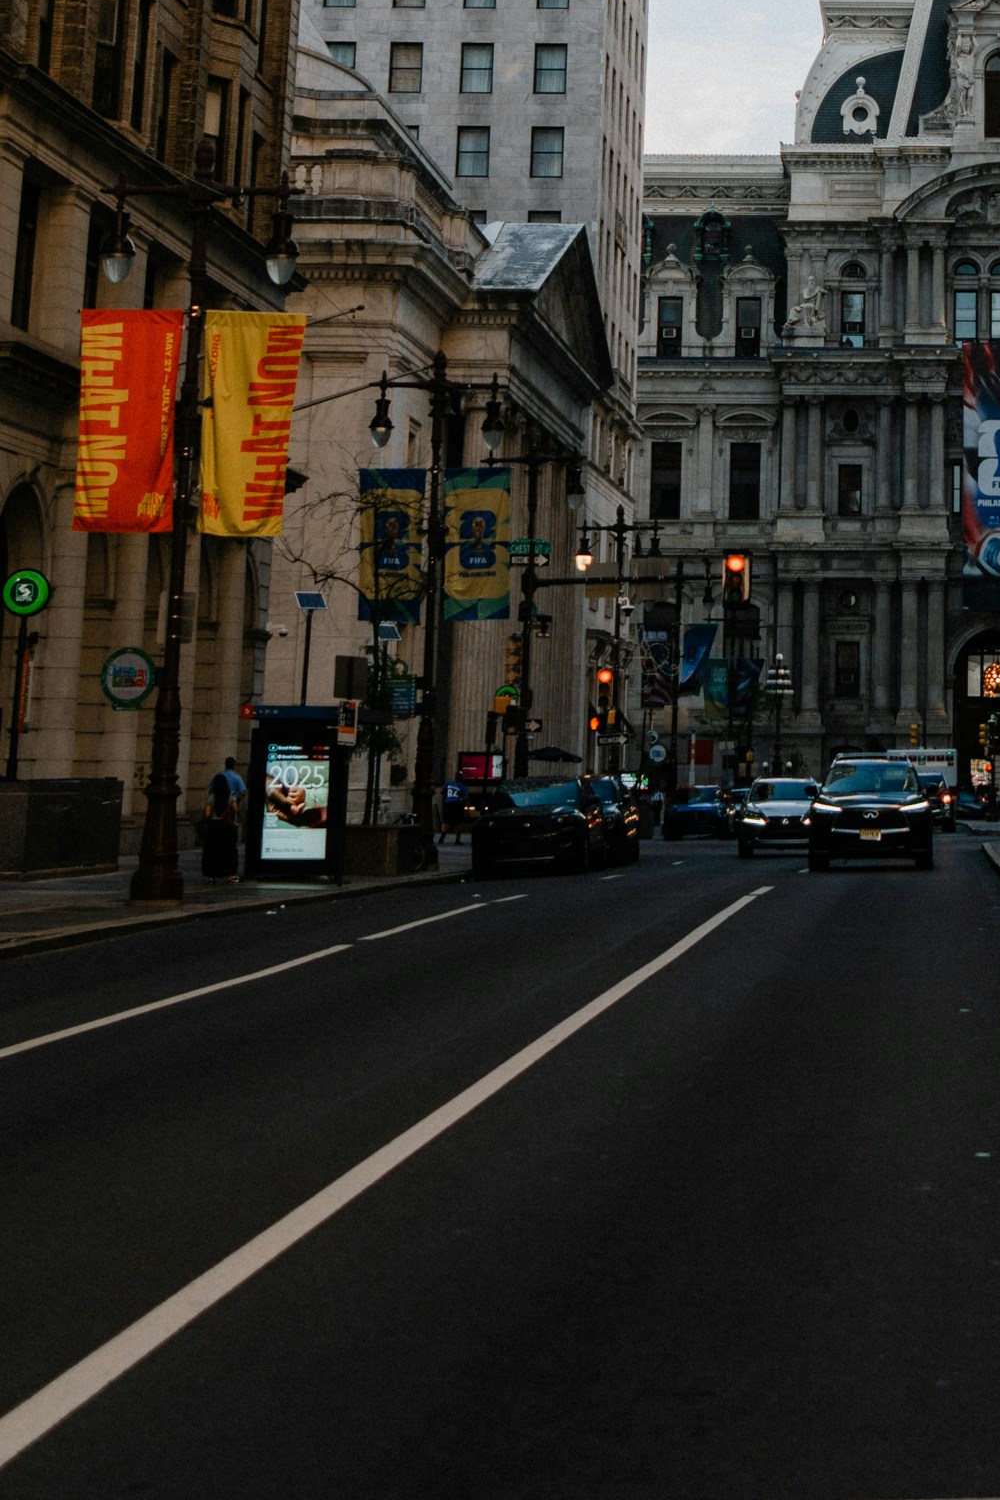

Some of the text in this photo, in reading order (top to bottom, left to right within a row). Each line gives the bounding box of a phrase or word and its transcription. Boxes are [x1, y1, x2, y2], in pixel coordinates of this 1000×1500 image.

[164, 332, 174, 357] MAY
[163, 358, 173, 373] 27
[161, 384, 171, 414] JULY
[75, 322, 129, 518] WHAT NOW
[240, 325, 306, 521] WHAT NOW
[469, 557, 487, 565] FIFA
[511, 544, 543, 554] CHESTUT
[268, 764, 326, 789] 2025
